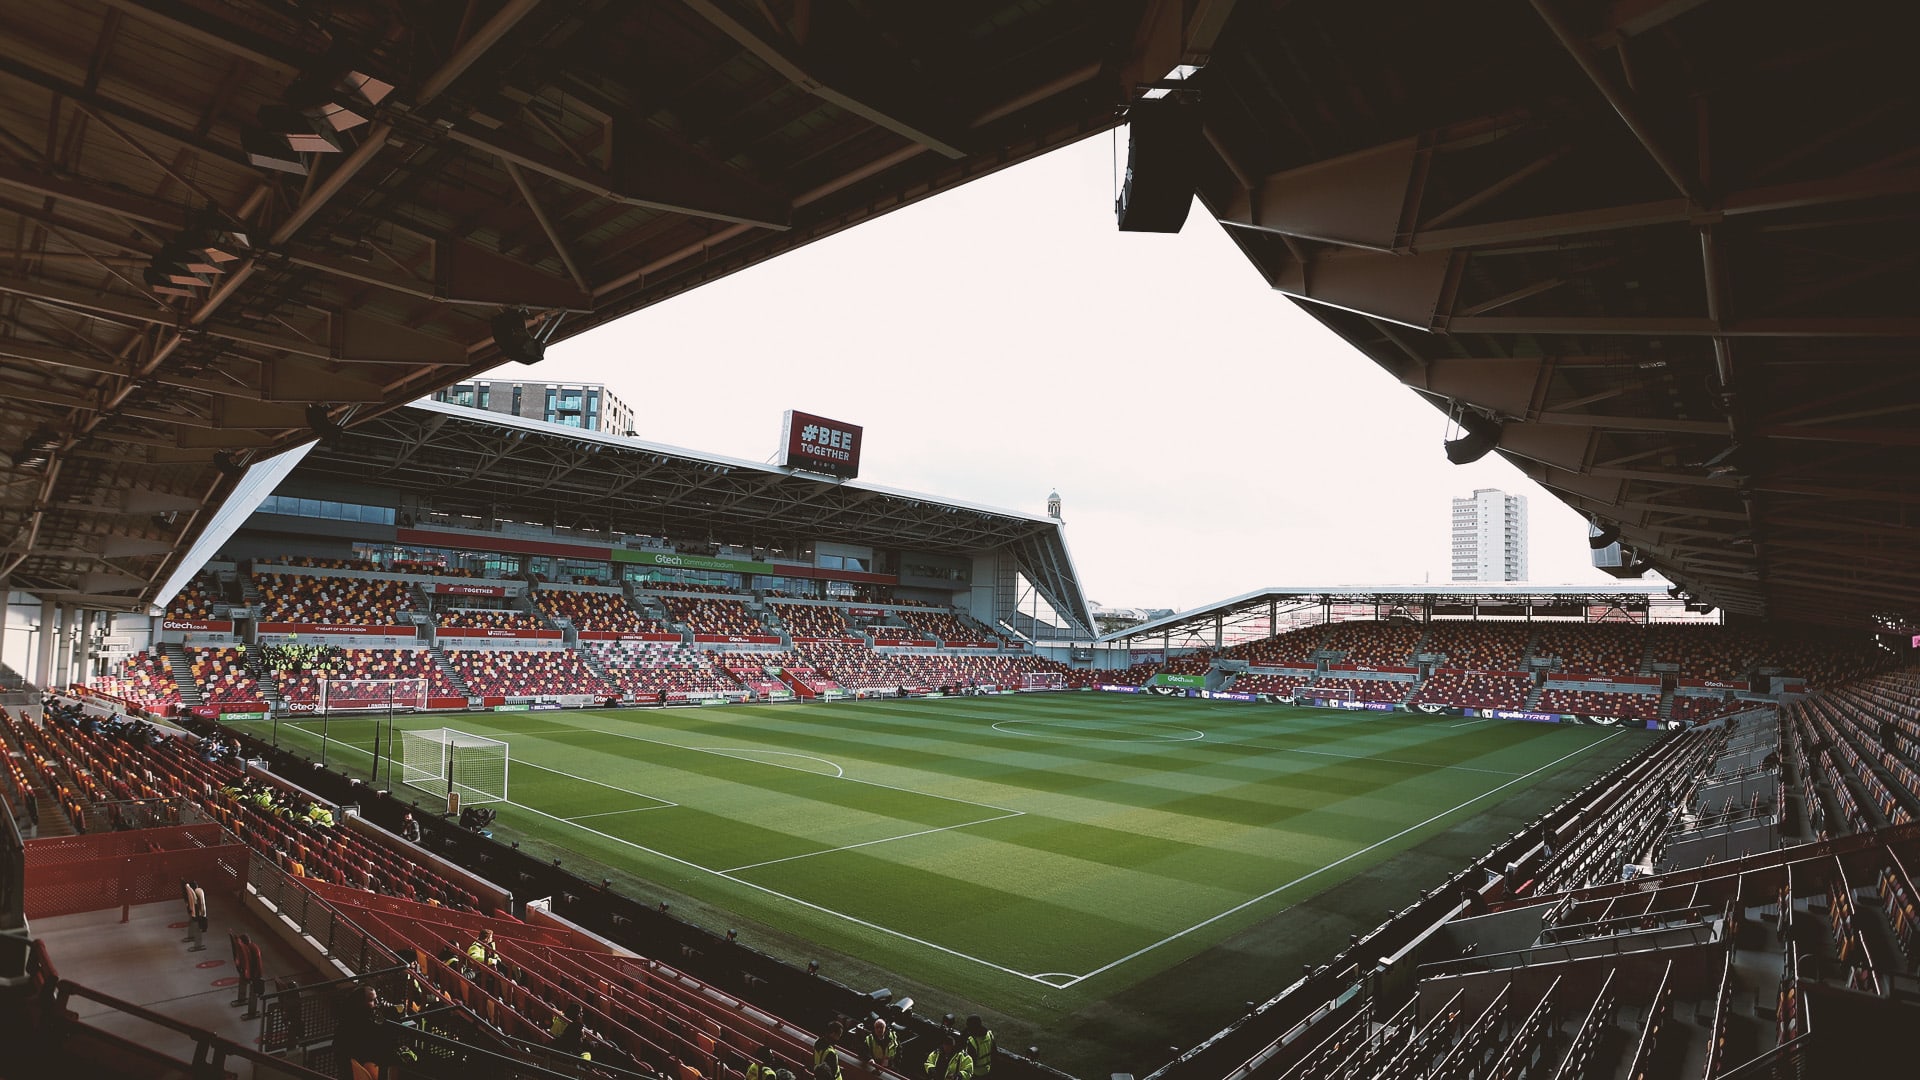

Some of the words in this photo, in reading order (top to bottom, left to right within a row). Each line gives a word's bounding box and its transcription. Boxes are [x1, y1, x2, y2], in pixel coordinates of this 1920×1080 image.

[801, 424, 853, 450] #BEE
[801, 443, 850, 461] TOGETHER
[655, 554, 682, 565] Gtech
[684, 559, 714, 567] Community
[713, 561, 734, 569] Stadium
[163, 621, 208, 630] Gtech.co.uk
[1498, 711, 1524, 720] apollo
[1524, 713, 1551, 721] TYRES
